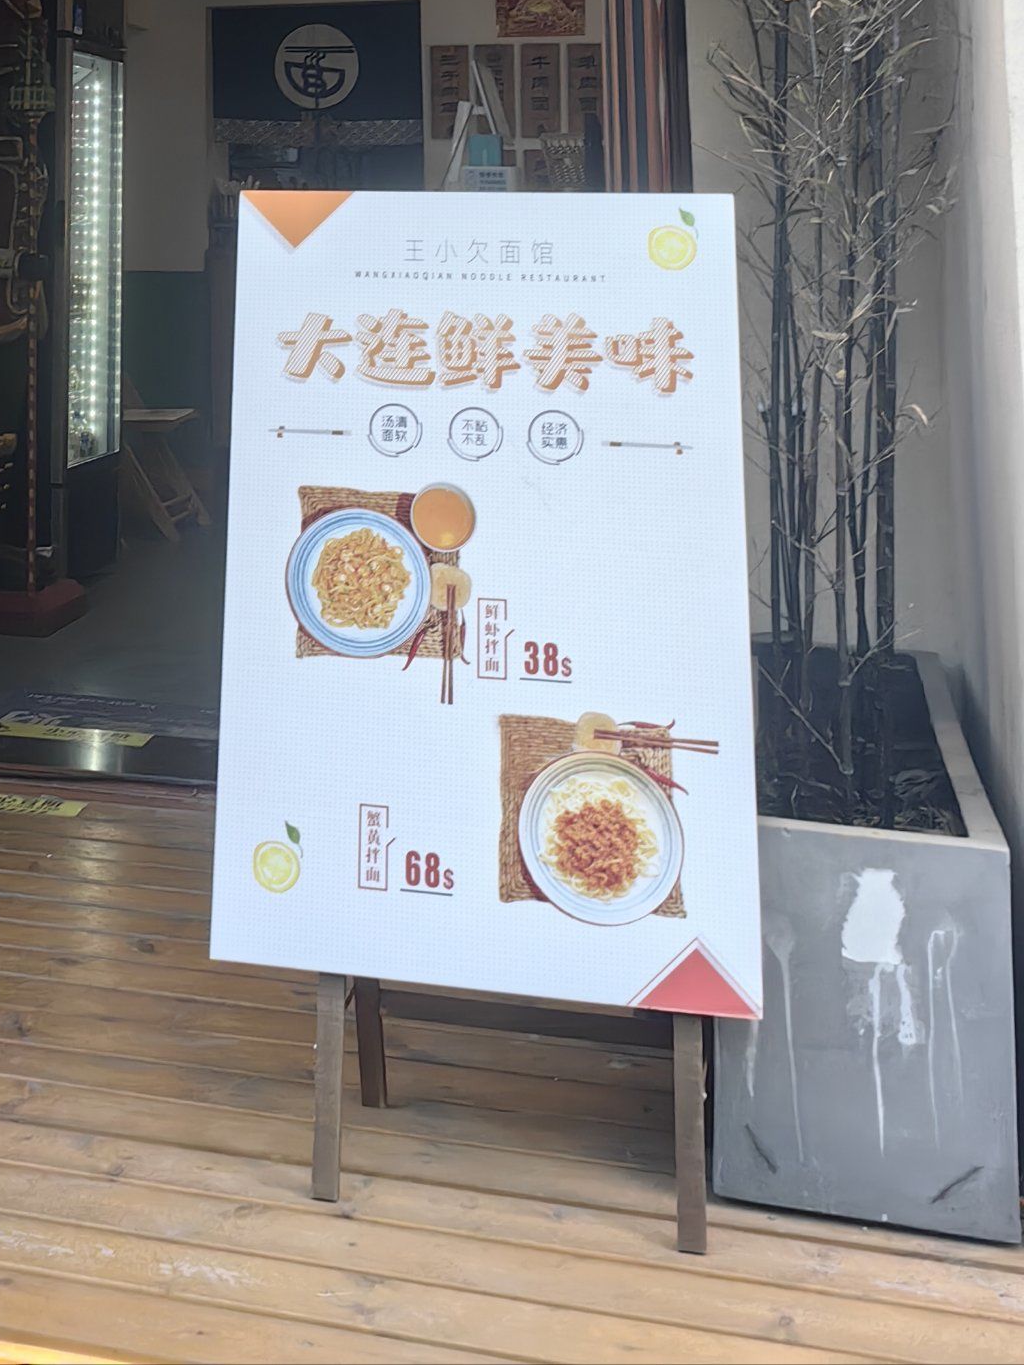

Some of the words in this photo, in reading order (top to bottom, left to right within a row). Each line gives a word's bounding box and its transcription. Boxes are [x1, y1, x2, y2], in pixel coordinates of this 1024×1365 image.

[403, 238, 554, 265] 王小欠面馆
[461, 272, 513, 282] NOODLE
[520, 273, 607, 283] RESTAURANT
[276, 307, 695, 395] 大连鲜美味
[541, 422, 568, 435] 经济
[541, 436, 568, 450] 实惠
